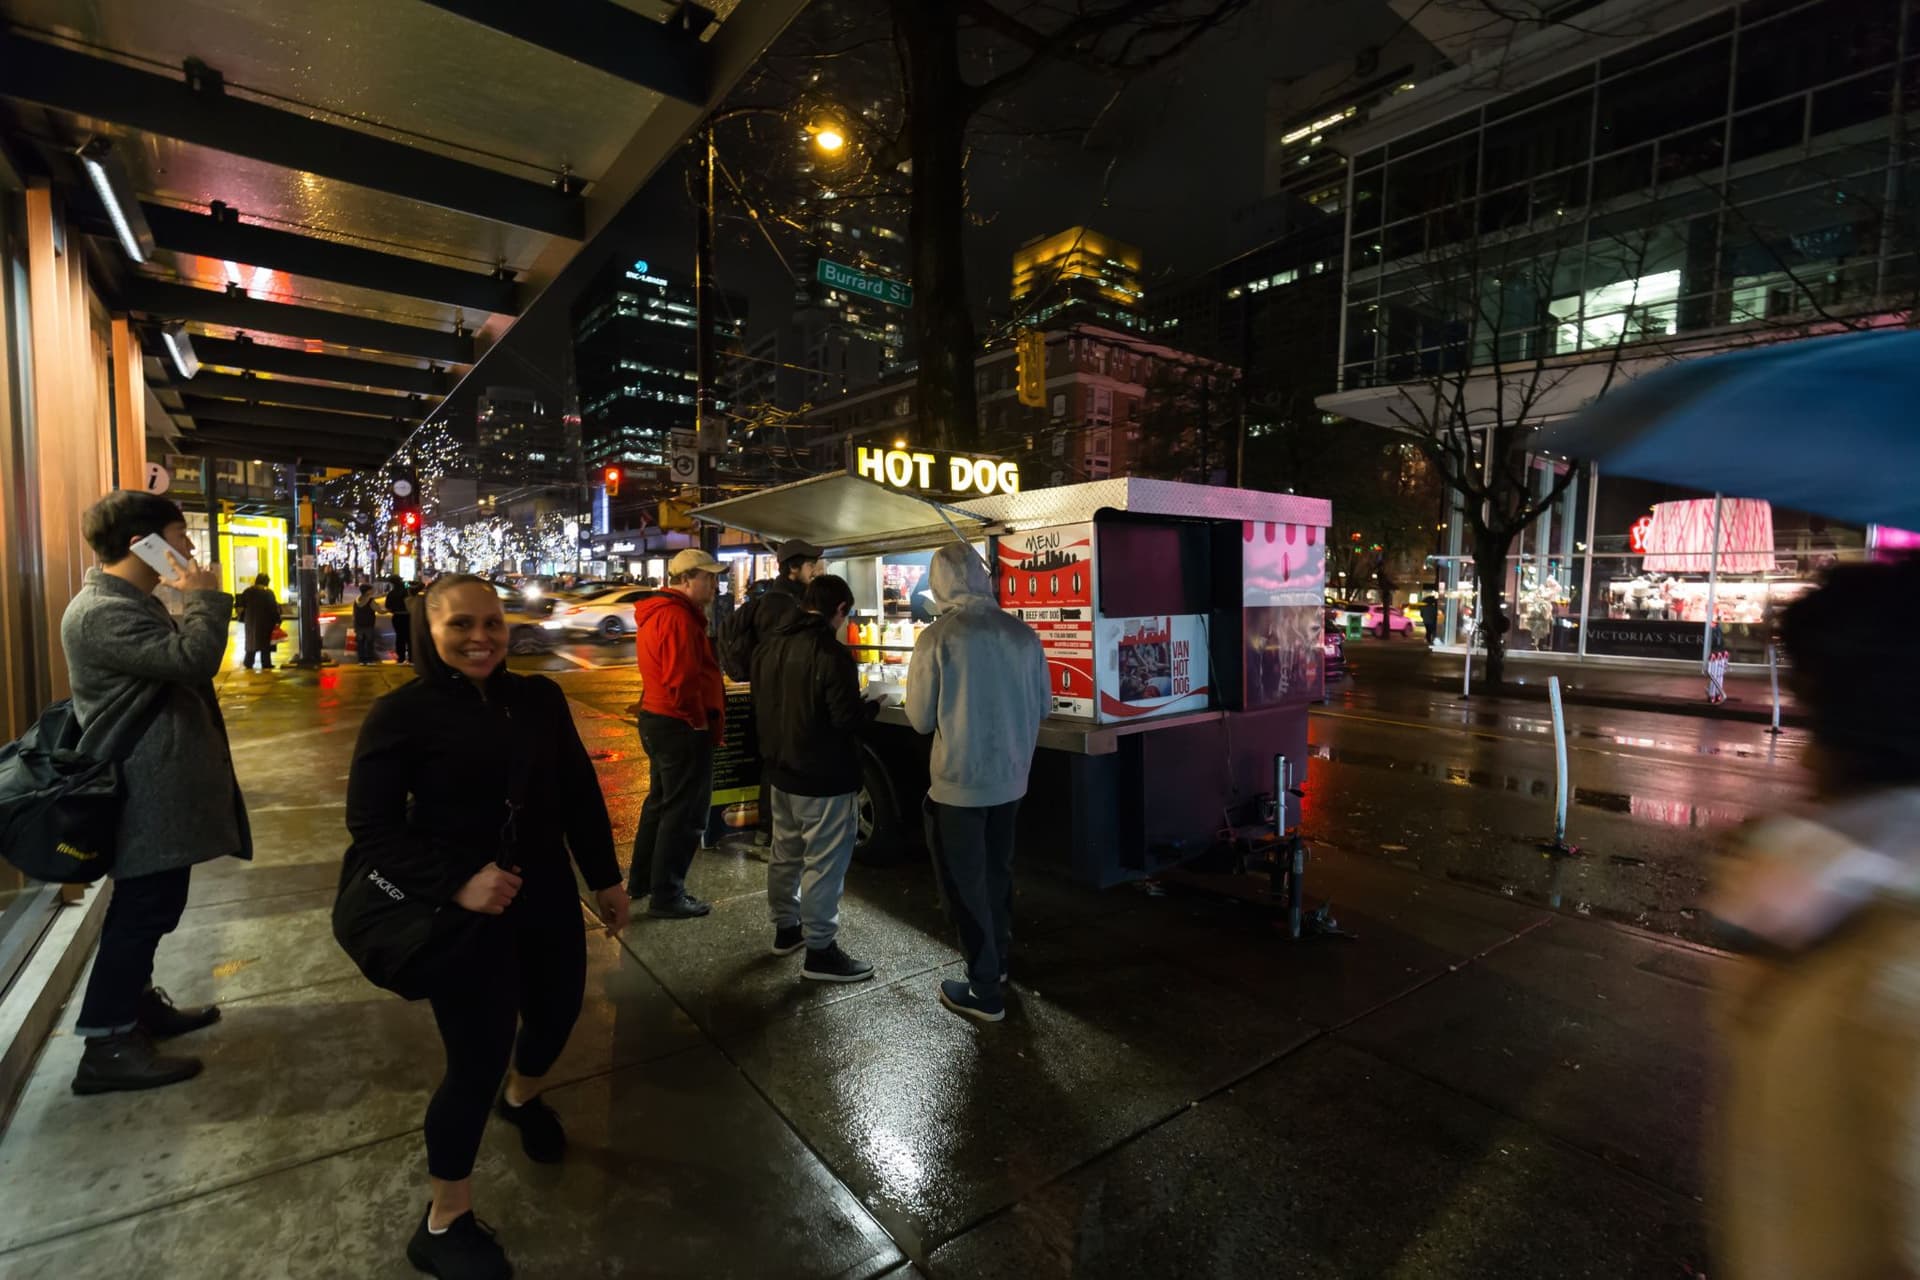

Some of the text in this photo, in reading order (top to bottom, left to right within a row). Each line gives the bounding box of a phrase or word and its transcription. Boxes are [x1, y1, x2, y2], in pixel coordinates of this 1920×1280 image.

[824, 264, 883, 295] Burrard
[857, 446, 1021, 496] HOT DOG
[1025, 531, 1060, 552] MENU
[1025, 610, 1038, 620] BEEF
[1038, 610, 1048, 620] HOT
[1049, 609, 1060, 620] DOG
[1587, 629, 1664, 642] VICTORIA'S
[1173, 640, 1190, 659] VAN
[1173, 659, 1190, 677] HOT
[1173, 677, 1190, 695] DOG
